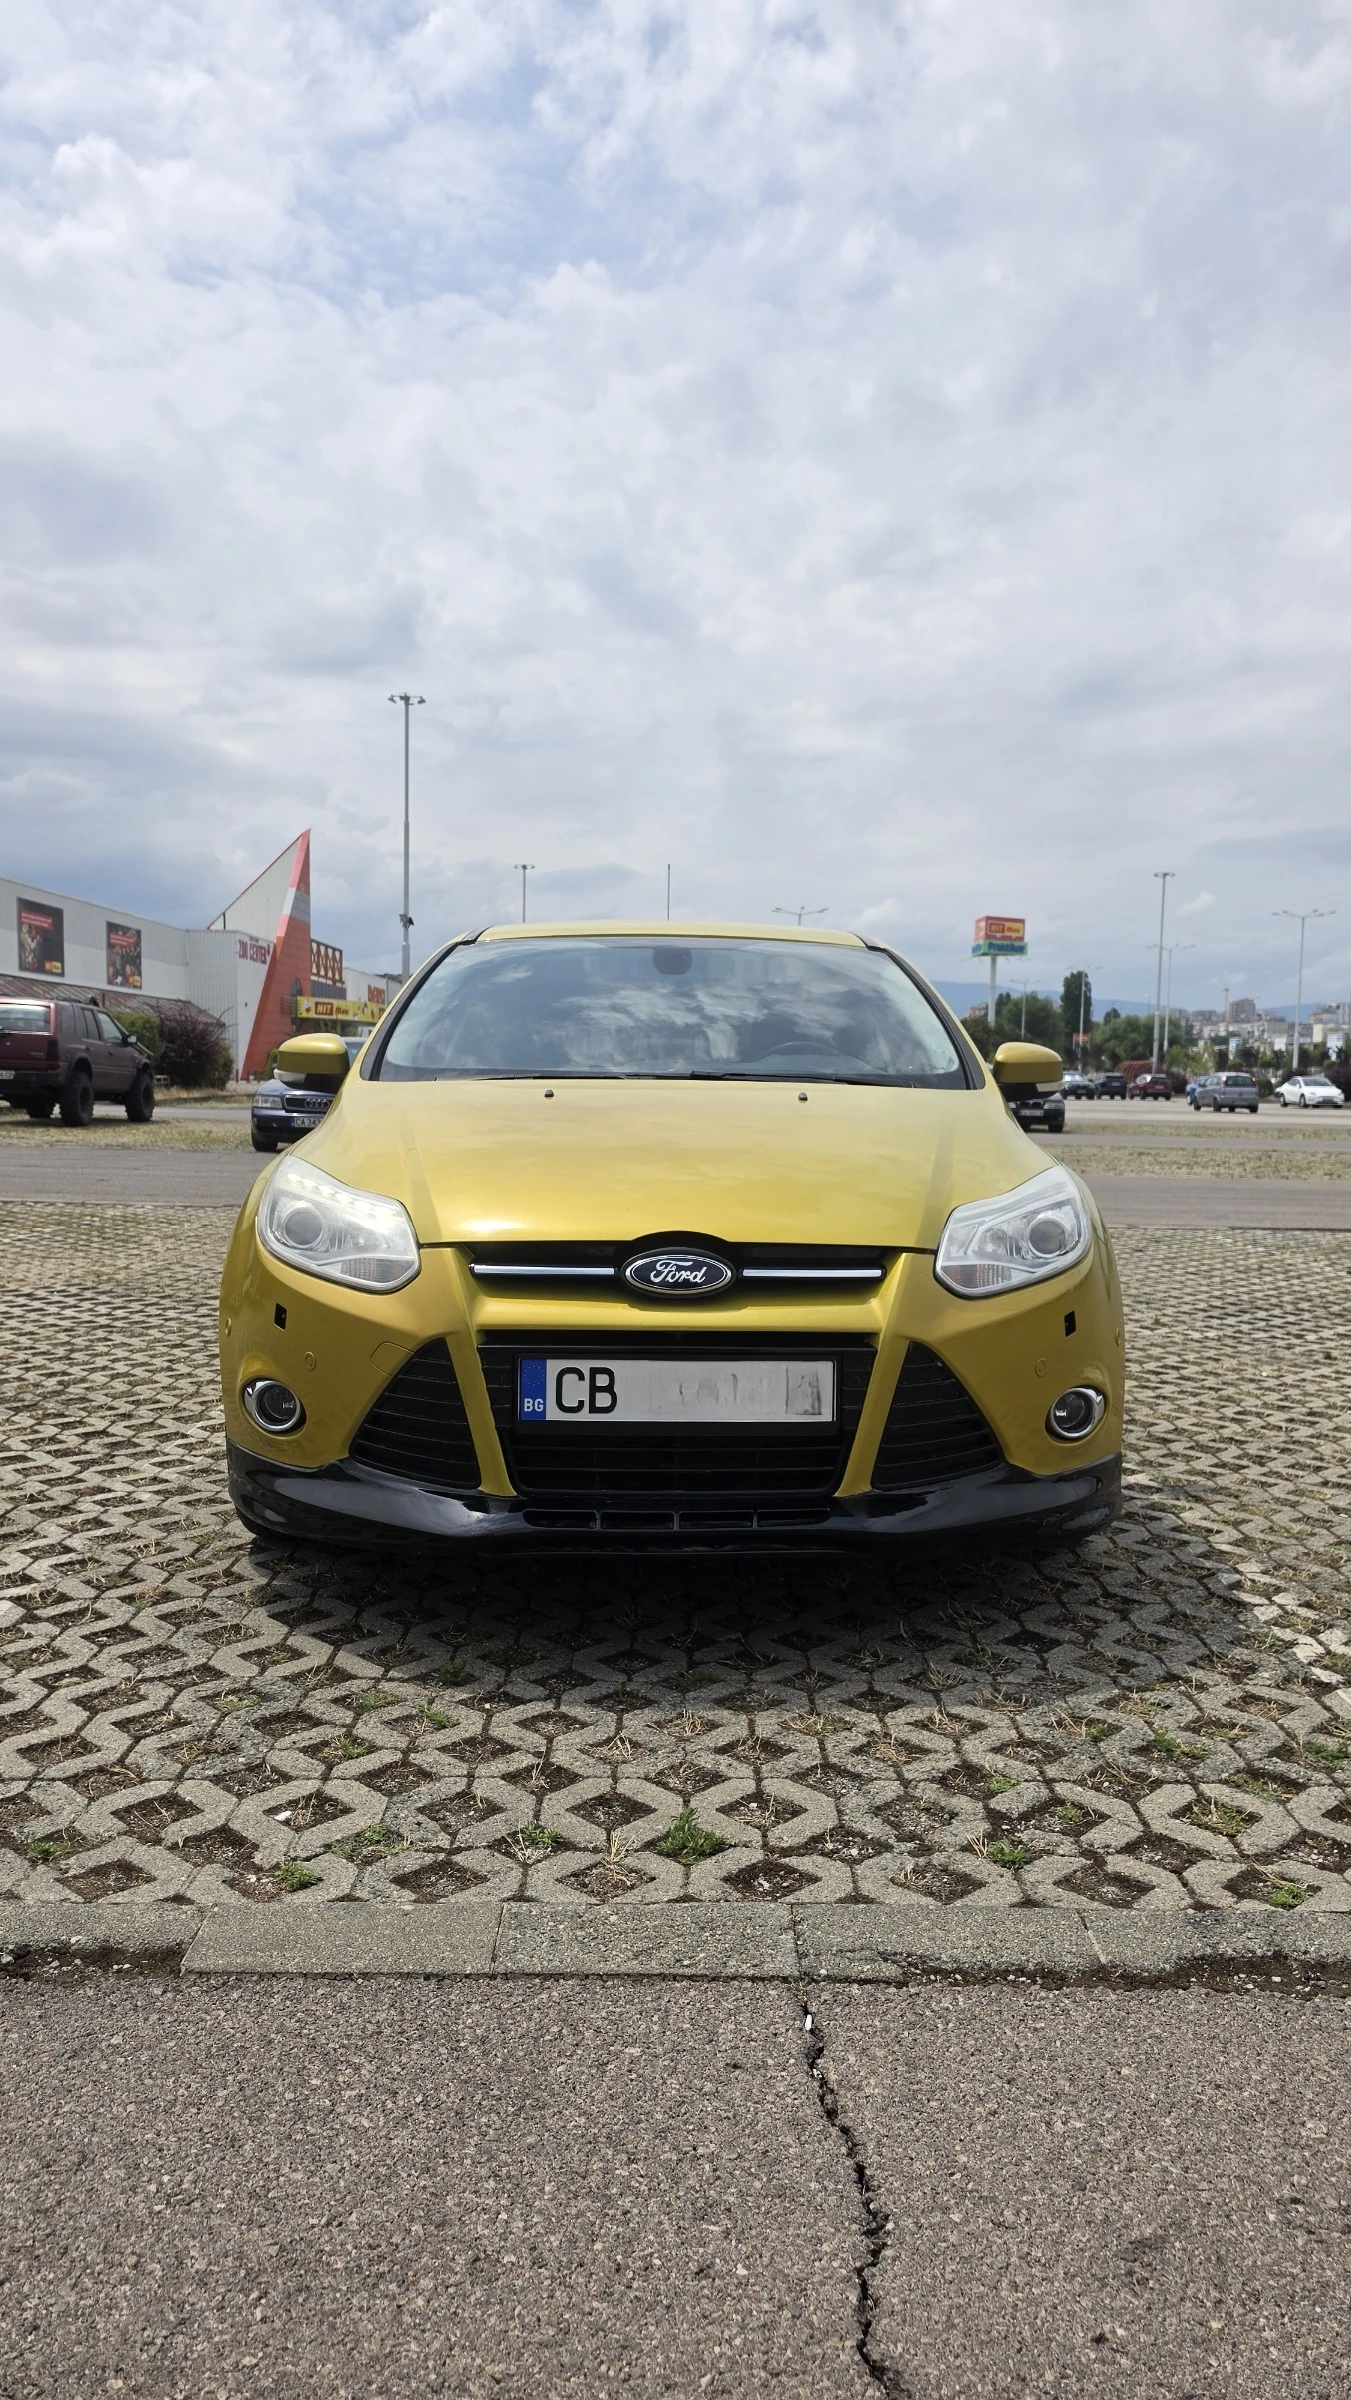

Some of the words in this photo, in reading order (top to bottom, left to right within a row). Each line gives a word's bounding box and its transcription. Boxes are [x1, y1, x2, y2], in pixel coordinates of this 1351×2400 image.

[238, 939, 248, 960] ZOO
[249, 943, 267, 965] CENTER
[316, 1003, 331, 1015] HIT
[651, 1260, 706, 1284] Ford
[555, 1366, 618, 1414] CB
[524, 1398, 544, 1412] BG
